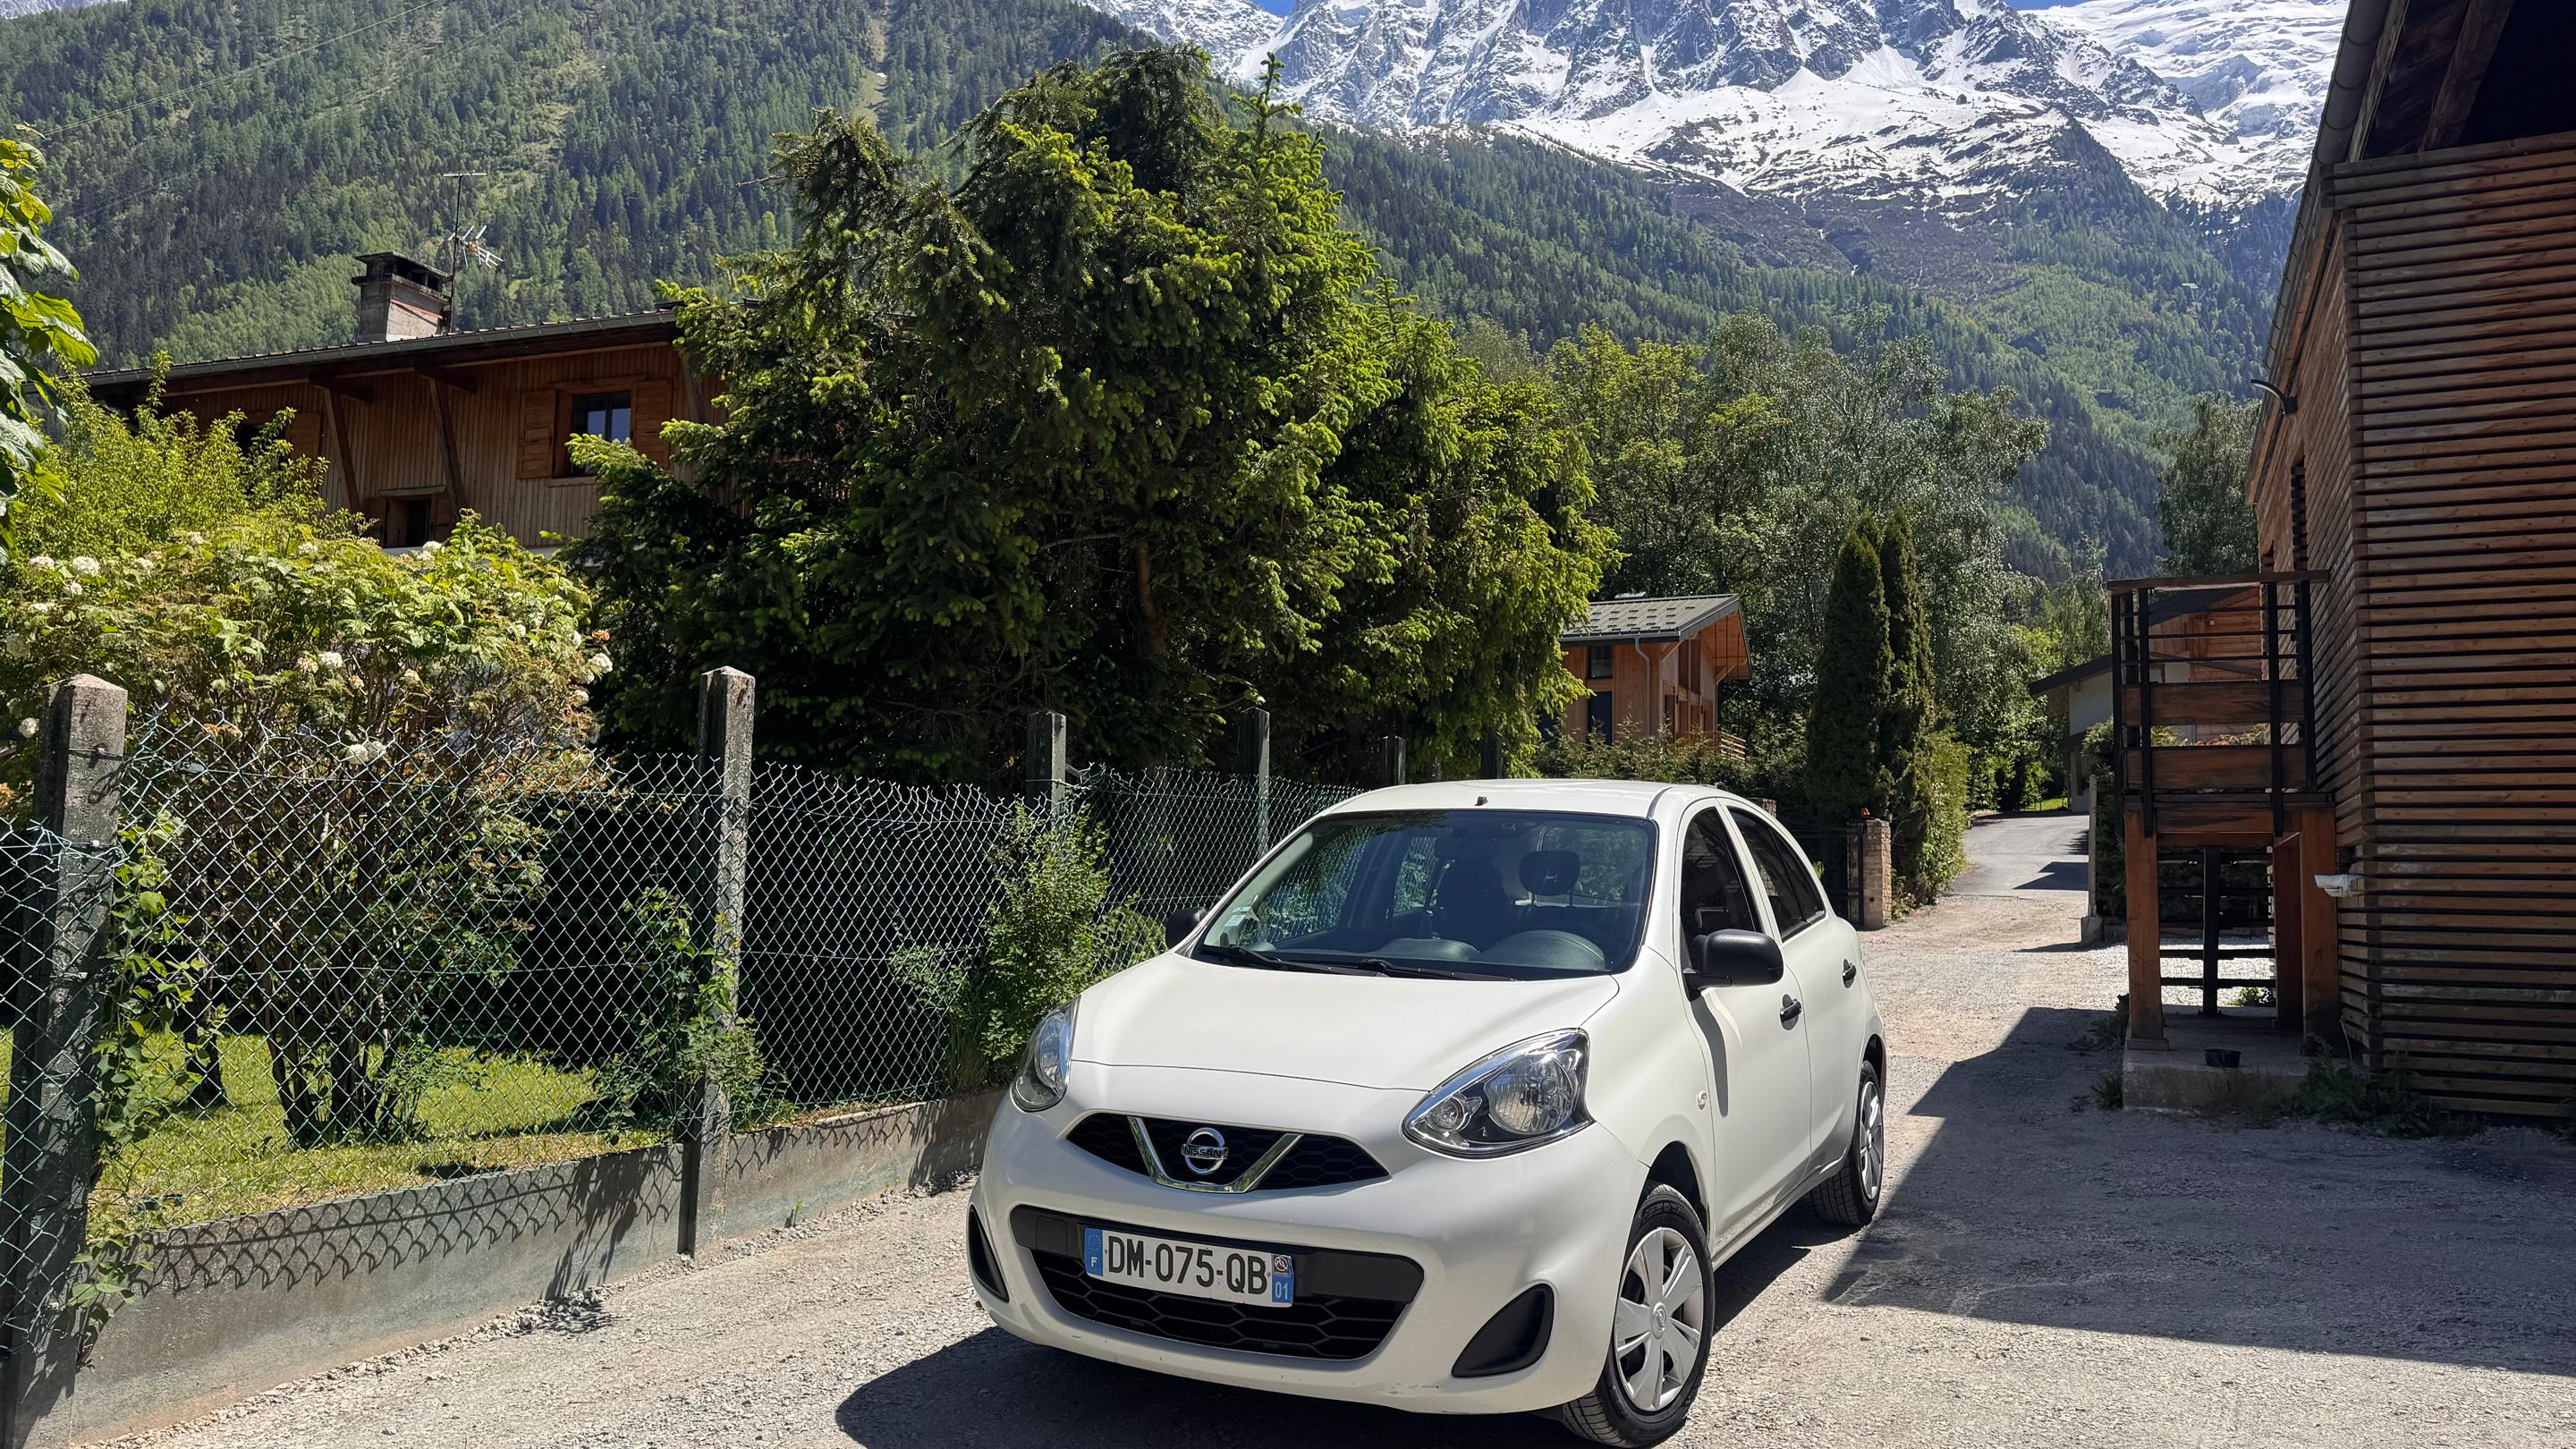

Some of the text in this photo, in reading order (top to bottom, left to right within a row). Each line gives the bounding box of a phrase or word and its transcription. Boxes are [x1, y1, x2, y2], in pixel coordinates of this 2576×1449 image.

[1182, 1145, 1221, 1157] NISSAN
[1090, 1257, 1098, 1267] F
[1108, 1235, 1267, 1295] DM-075-QB
[1275, 1281, 1288, 1300] 01
